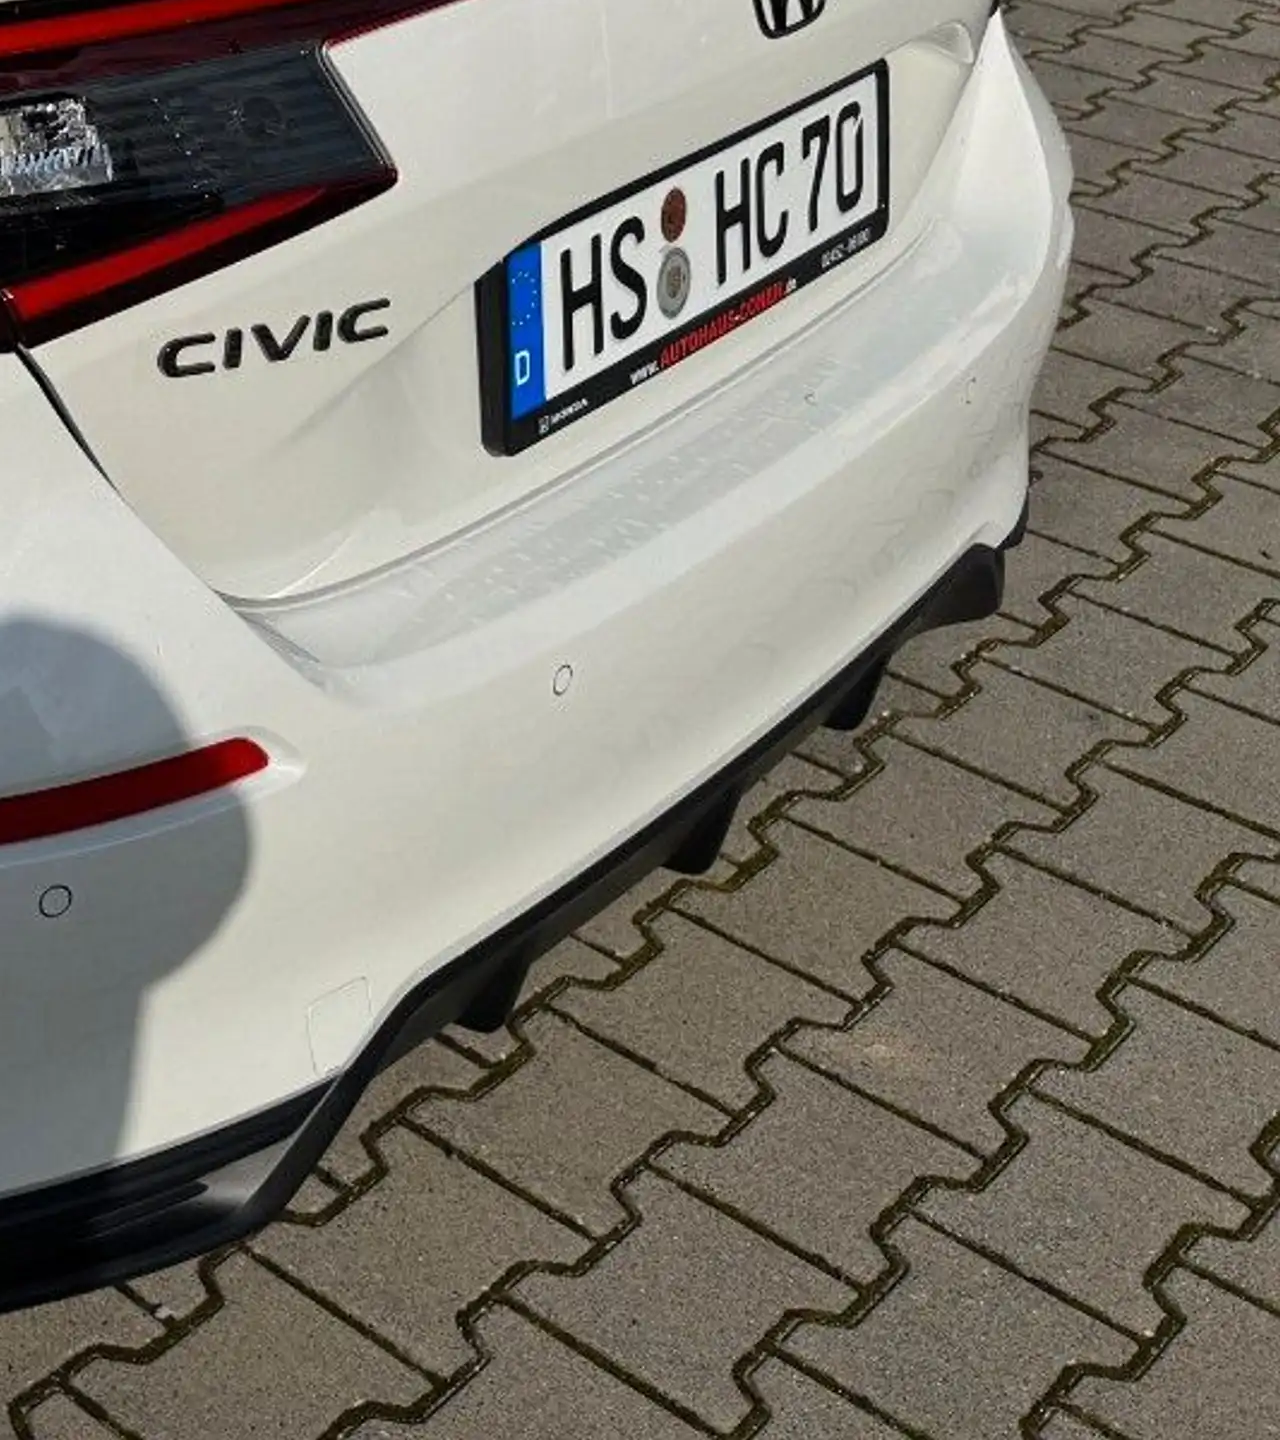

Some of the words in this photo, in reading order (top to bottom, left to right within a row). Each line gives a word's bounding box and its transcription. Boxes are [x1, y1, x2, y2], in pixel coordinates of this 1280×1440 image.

[514, 350, 530, 387] D
[560, 215, 648, 372] HS
[714, 142, 789, 288] HC
[801, 100, 864, 233] 70
[156, 297, 391, 378] CIVIC
